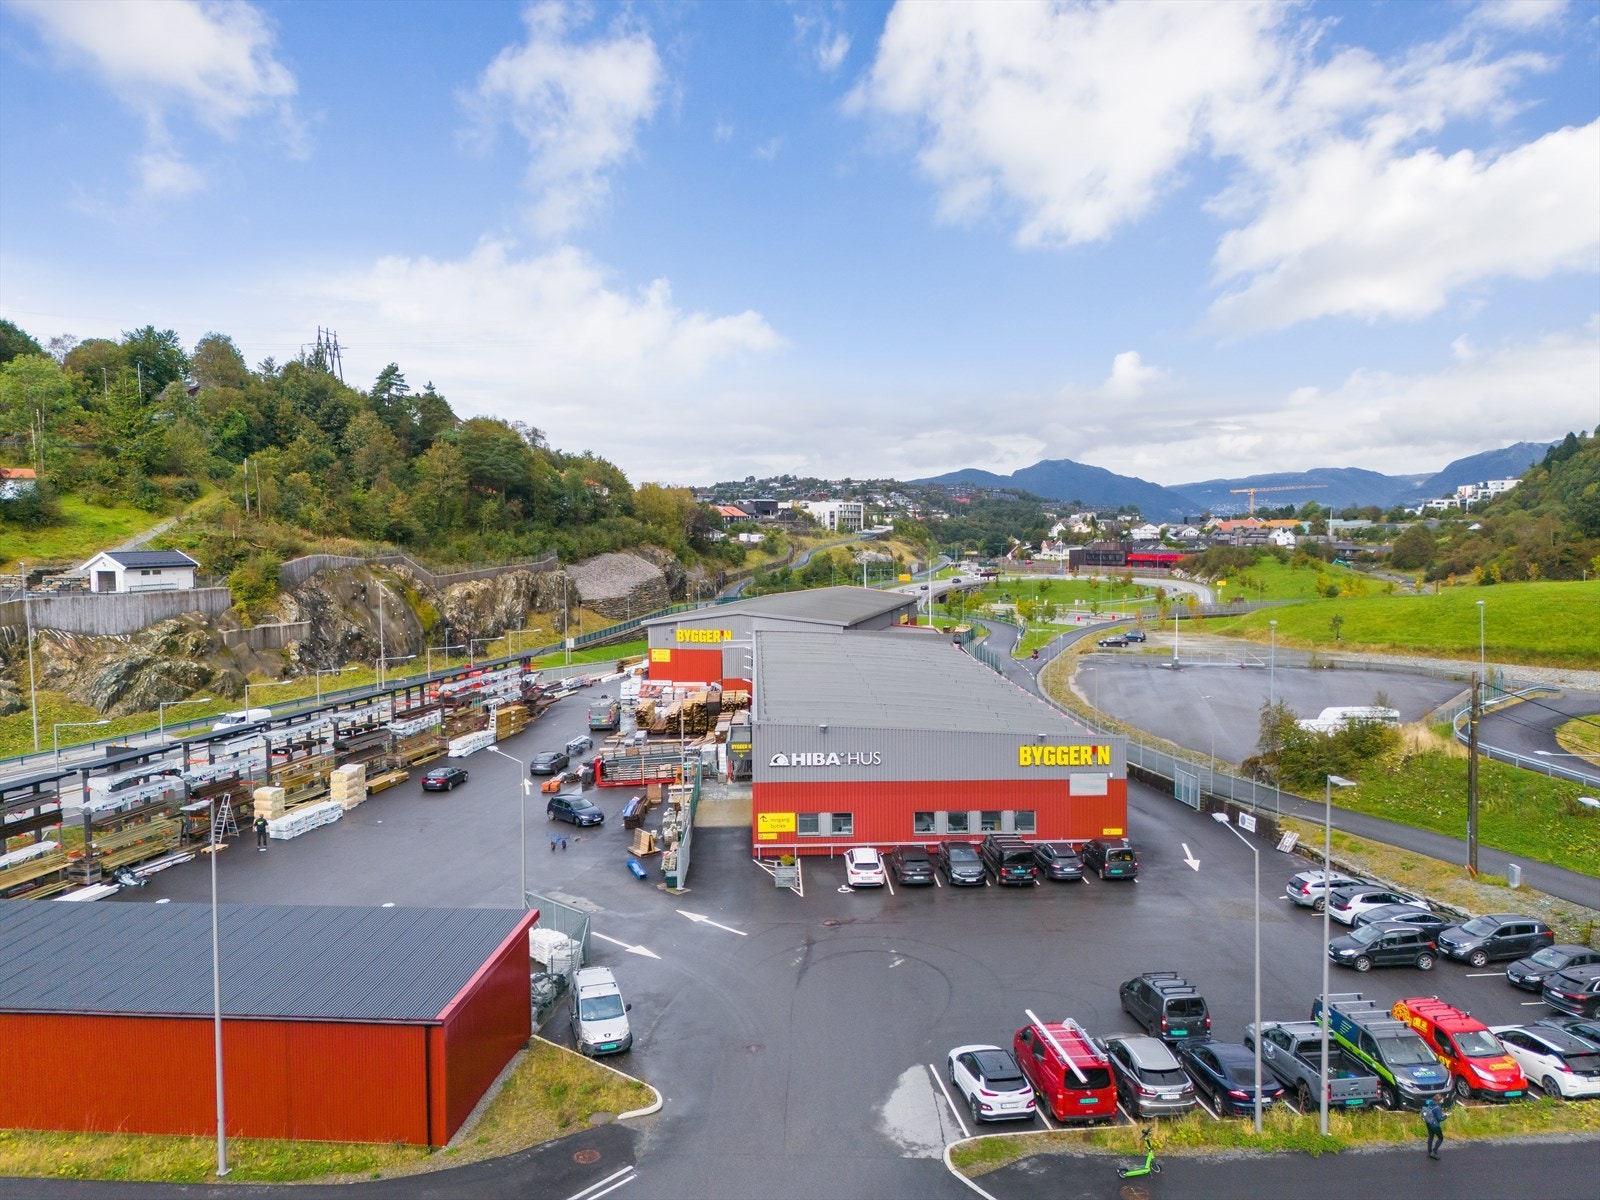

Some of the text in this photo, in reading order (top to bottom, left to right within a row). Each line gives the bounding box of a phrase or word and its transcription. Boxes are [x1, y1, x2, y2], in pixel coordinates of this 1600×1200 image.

[676, 629, 732, 643] BYGGER'N
[847, 751, 882, 765] HUS
[1019, 745, 1111, 766] BYGGER'N
